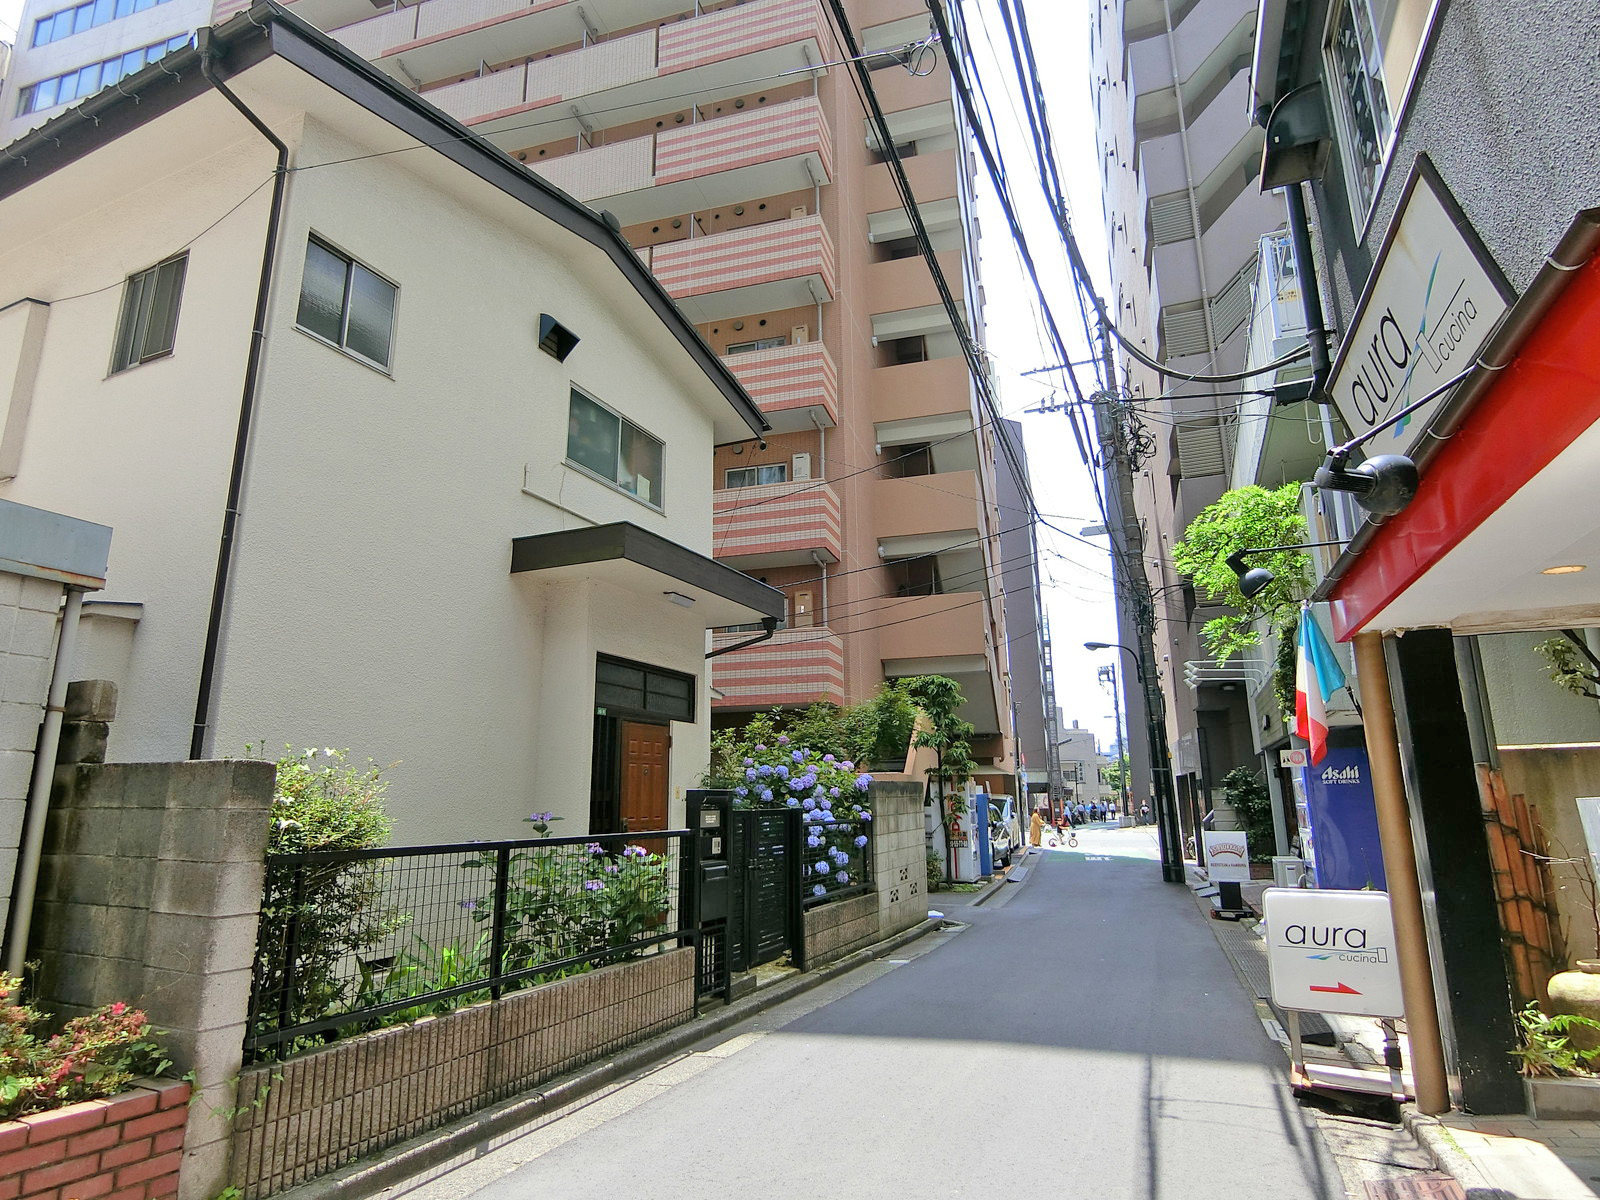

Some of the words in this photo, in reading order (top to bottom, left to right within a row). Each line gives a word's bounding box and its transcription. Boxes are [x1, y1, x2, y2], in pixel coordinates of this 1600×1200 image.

[1438, 297, 1477, 361] cucina
[1351, 307, 1412, 426] aura
[1321, 765, 1359, 779] Asahi
[1285, 924, 1367, 949] aura
[1338, 953, 1377, 964] cucina
